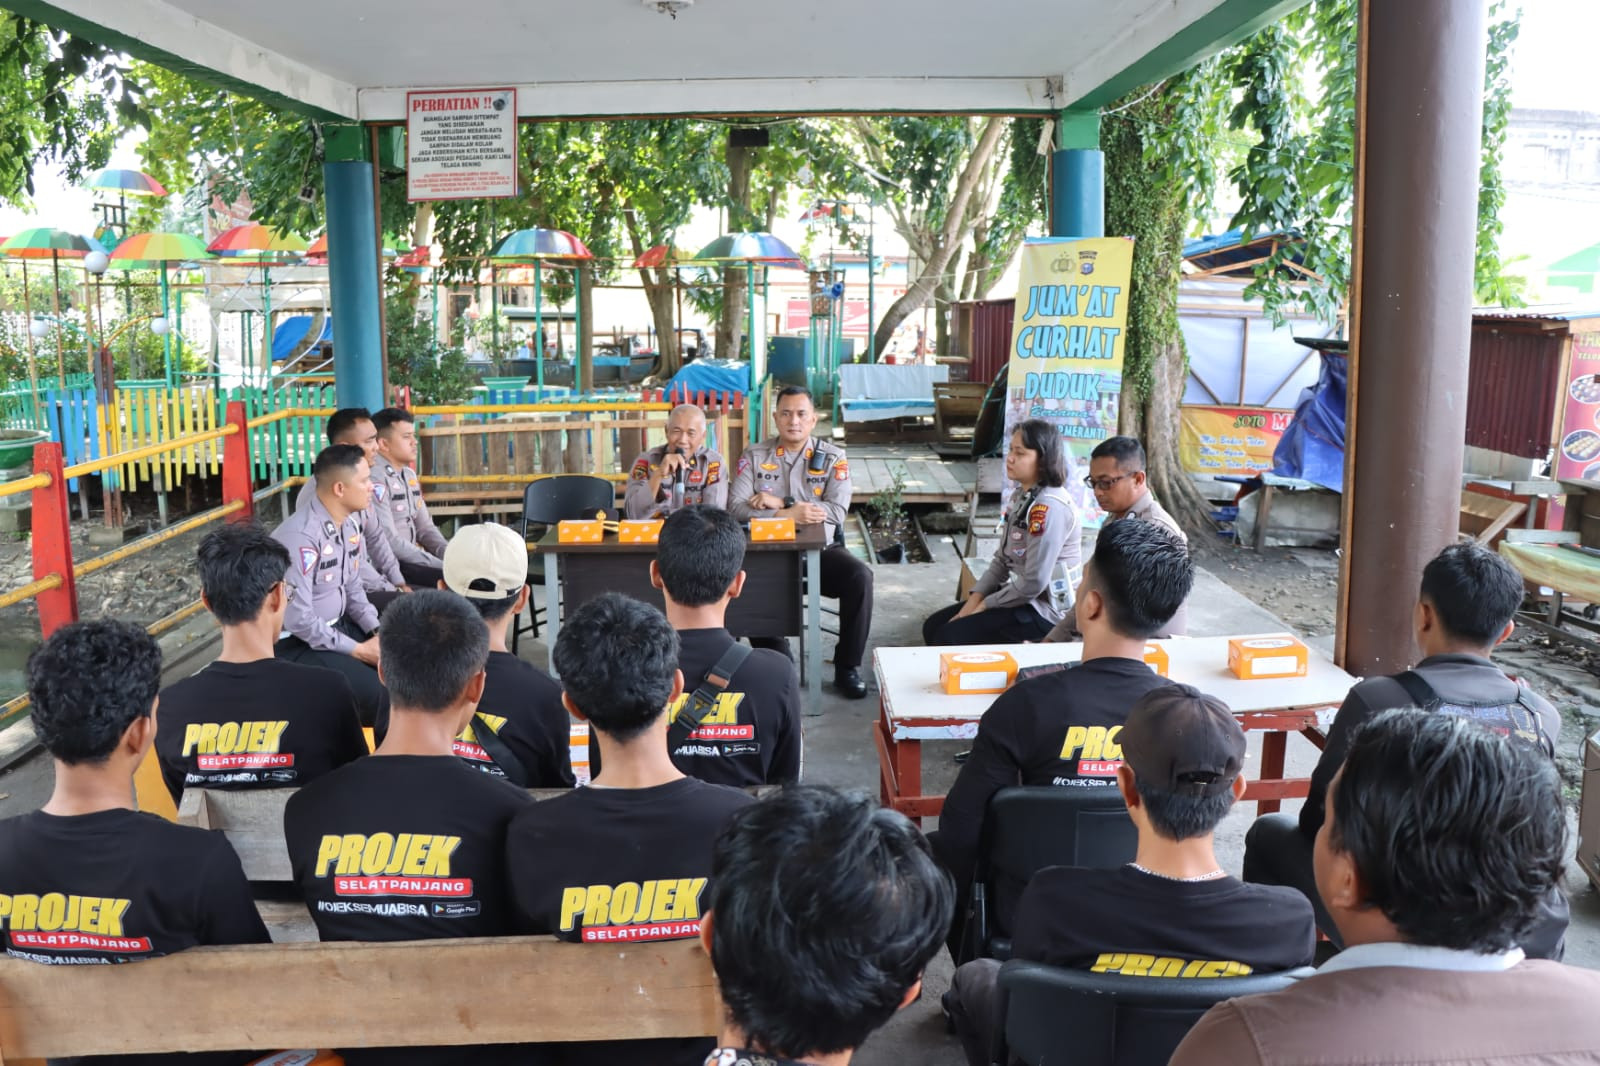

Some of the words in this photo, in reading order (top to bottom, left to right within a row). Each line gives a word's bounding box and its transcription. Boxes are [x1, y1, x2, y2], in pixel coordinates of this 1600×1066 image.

[413, 97, 479, 112] PERHATIAN
[484, 96, 492, 109] !!
[1016, 324, 1121, 360] CURHAT
[1025, 371, 1101, 402] DUDUK
[1030, 404, 1090, 419] Bersama
[1234, 415, 1266, 429] SOTO
[181, 720, 289, 758] PROJEK
[201, 756, 278, 766] SELATPANJANG
[315, 832, 462, 878] PROJEK
[339, 880, 464, 893] SELATPANJANG
[317, 900, 430, 918] #OJEKSEMUABISA
[559, 878, 708, 931] PROJEK
[0, 892, 132, 938] PROJEK
[587, 924, 702, 941] SELATPANJAN
[17, 934, 142, 949] SELATPANJANG
